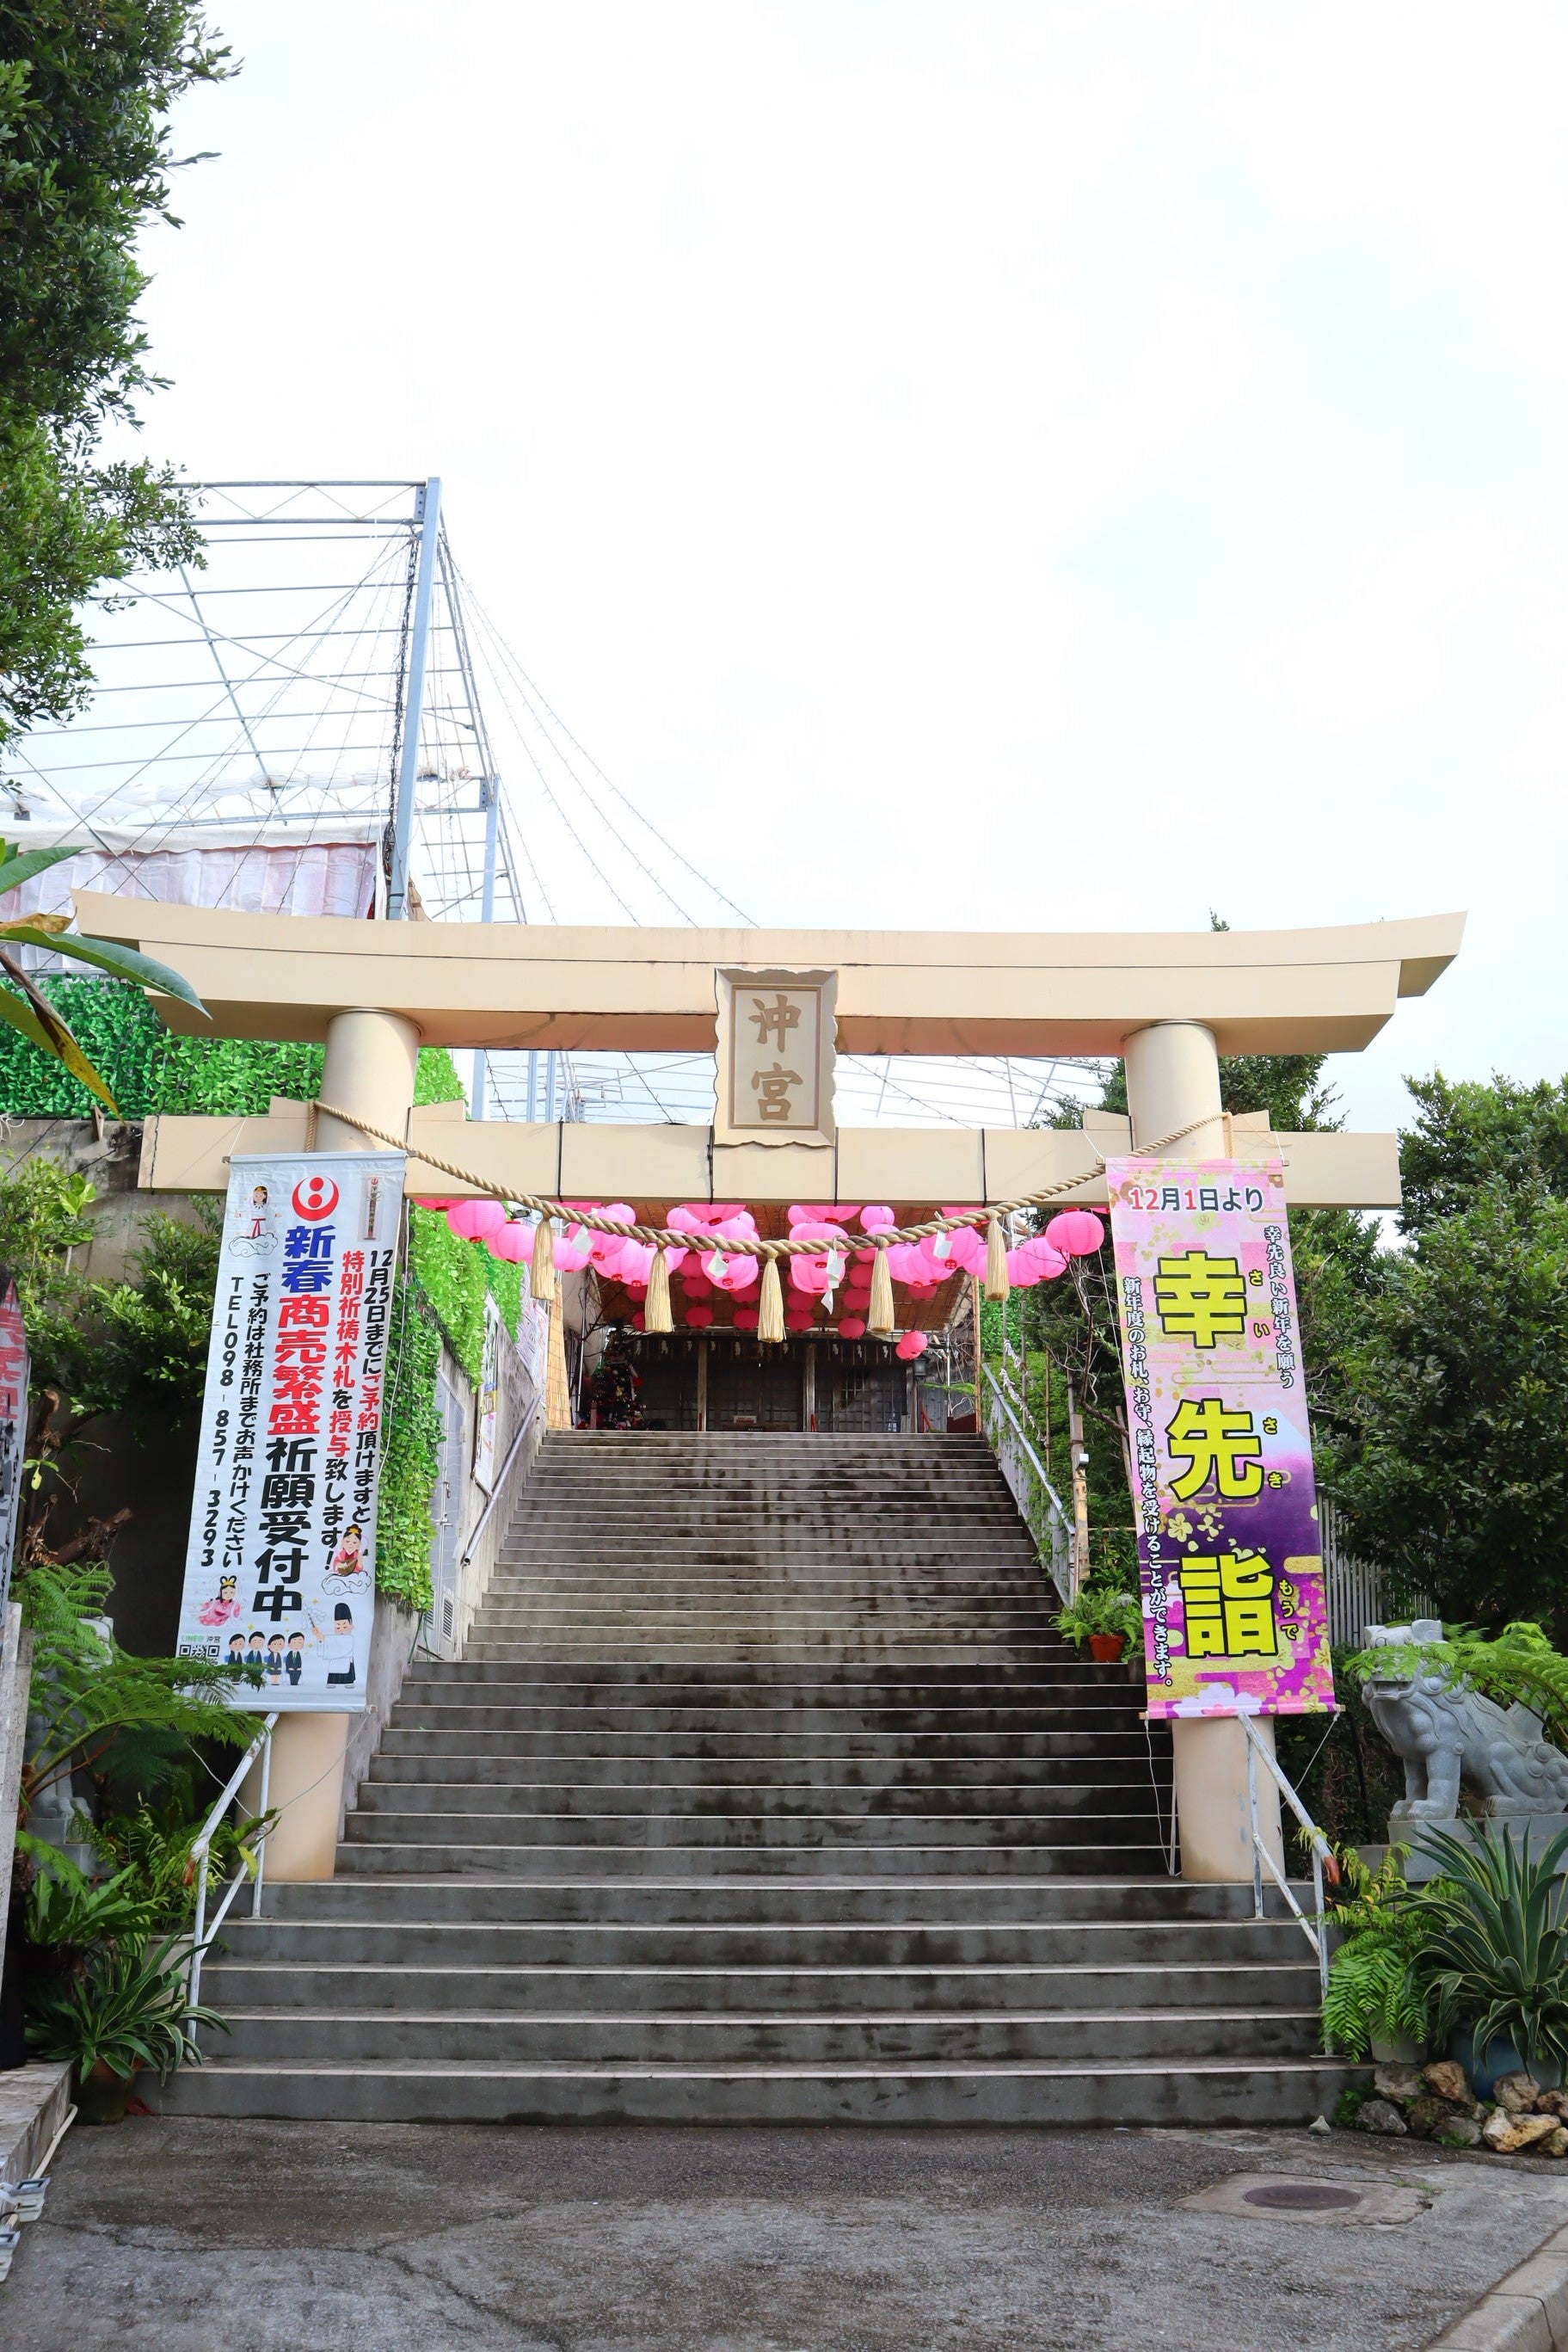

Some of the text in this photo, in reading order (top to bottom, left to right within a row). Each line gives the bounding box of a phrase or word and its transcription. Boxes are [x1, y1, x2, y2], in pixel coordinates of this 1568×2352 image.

[748, 994, 803, 1121] 沖宮
[1129, 1186, 1264, 1212] 12月1日より
[1264, 1225, 1294, 1388] 幸先良い新年を願う
[223, 1272, 272, 1567] ご予約は社務所までお声かけください
[252, 1224, 336, 1622] 新春商売繁盛祈願受付中
[352, 1249, 394, 1524] 12月25日までにご予約頂けますと
[1153, 1250, 1278, 1659] 幸先詣
[1279, 1579, 1299, 1641] もうで
